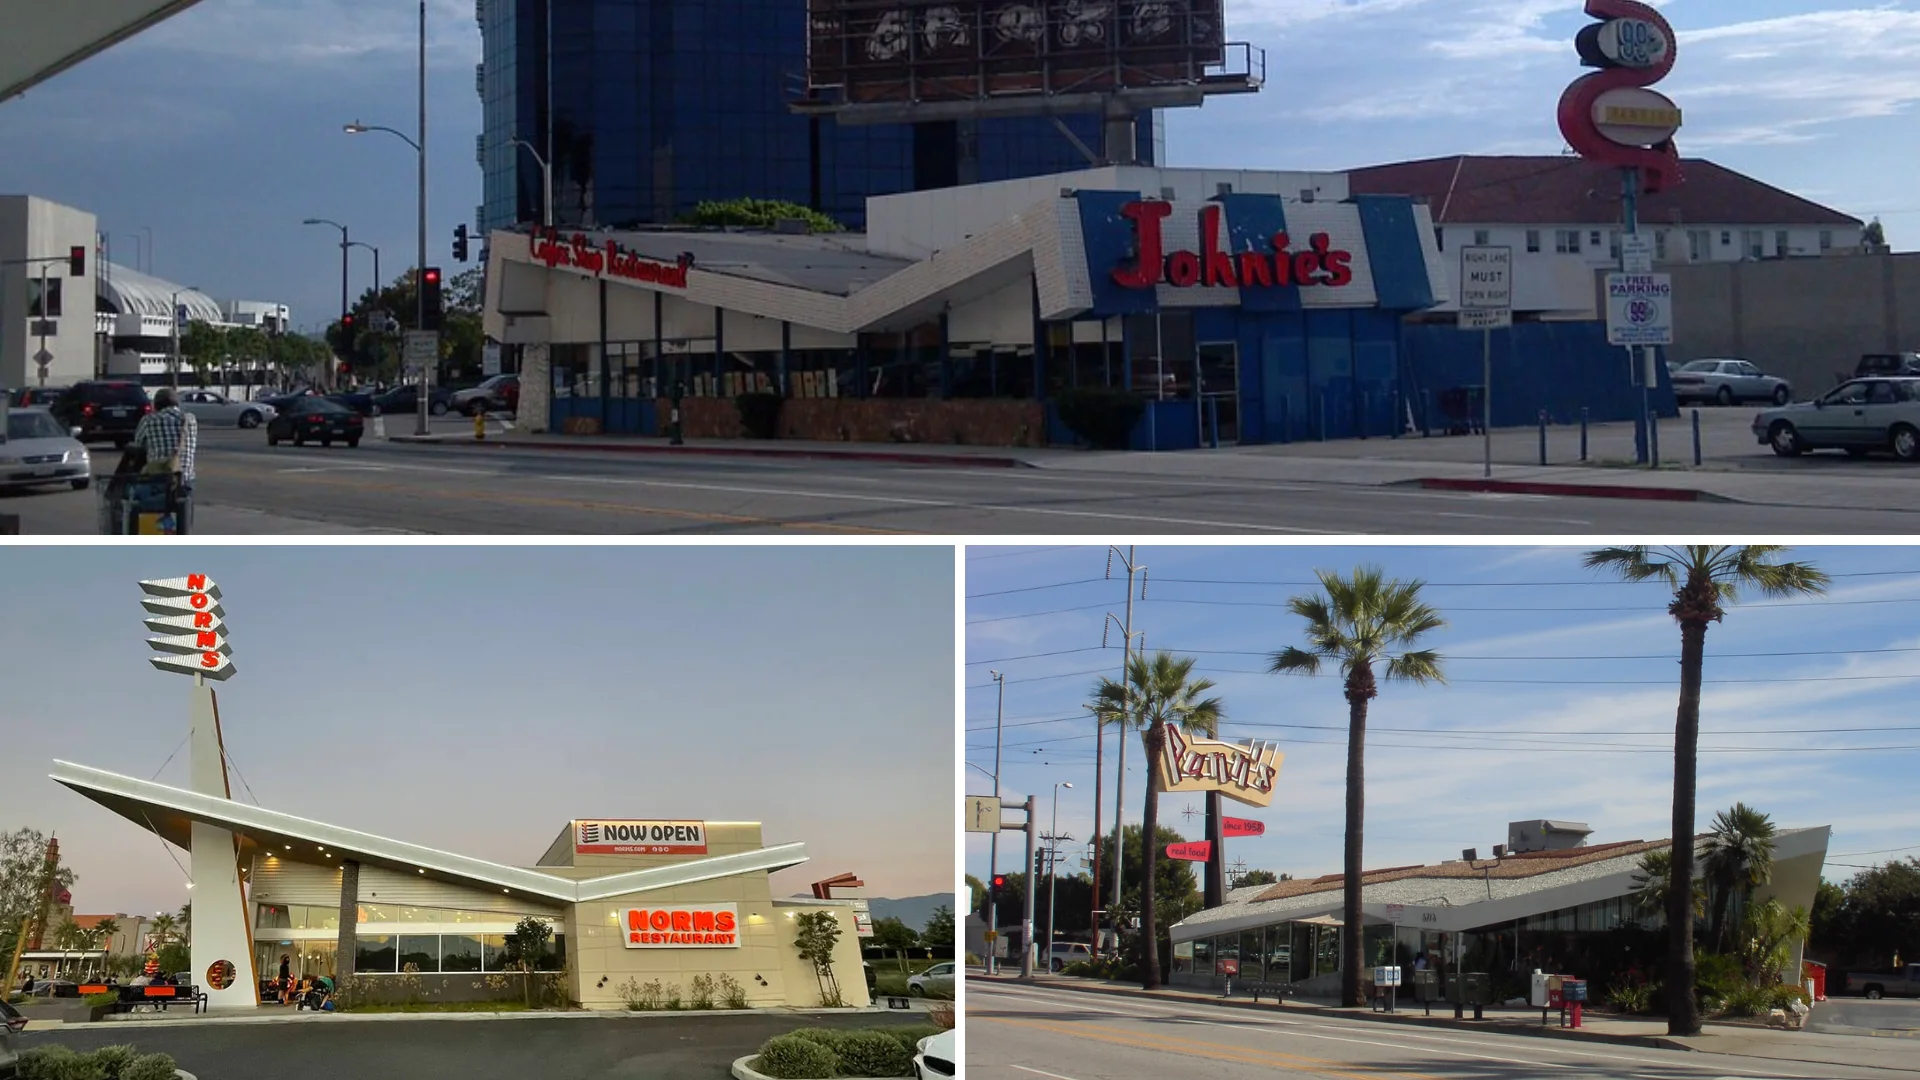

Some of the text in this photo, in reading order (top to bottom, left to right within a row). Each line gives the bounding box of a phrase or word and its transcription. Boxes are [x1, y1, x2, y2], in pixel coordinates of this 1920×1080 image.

[530, 224, 570, 267] Coffee
[572, 233, 602, 277] Shop
[1111, 201, 1352, 288] Johnie's
[1471, 271, 1502, 283] MUST
[1626, 276, 1653, 284] FREE
[1610, 284, 1669, 293] PARKING
[187, 573, 221, 667] NORMS
[1163, 722, 1276, 791] Pann's
[604, 825, 699, 841] NOW OPEN
[1223, 821, 1263, 832] since 1958
[1171, 845, 1206, 857] real food
[628, 910, 735, 931] NORMS
[629, 932, 736, 944] RESTAURANT
